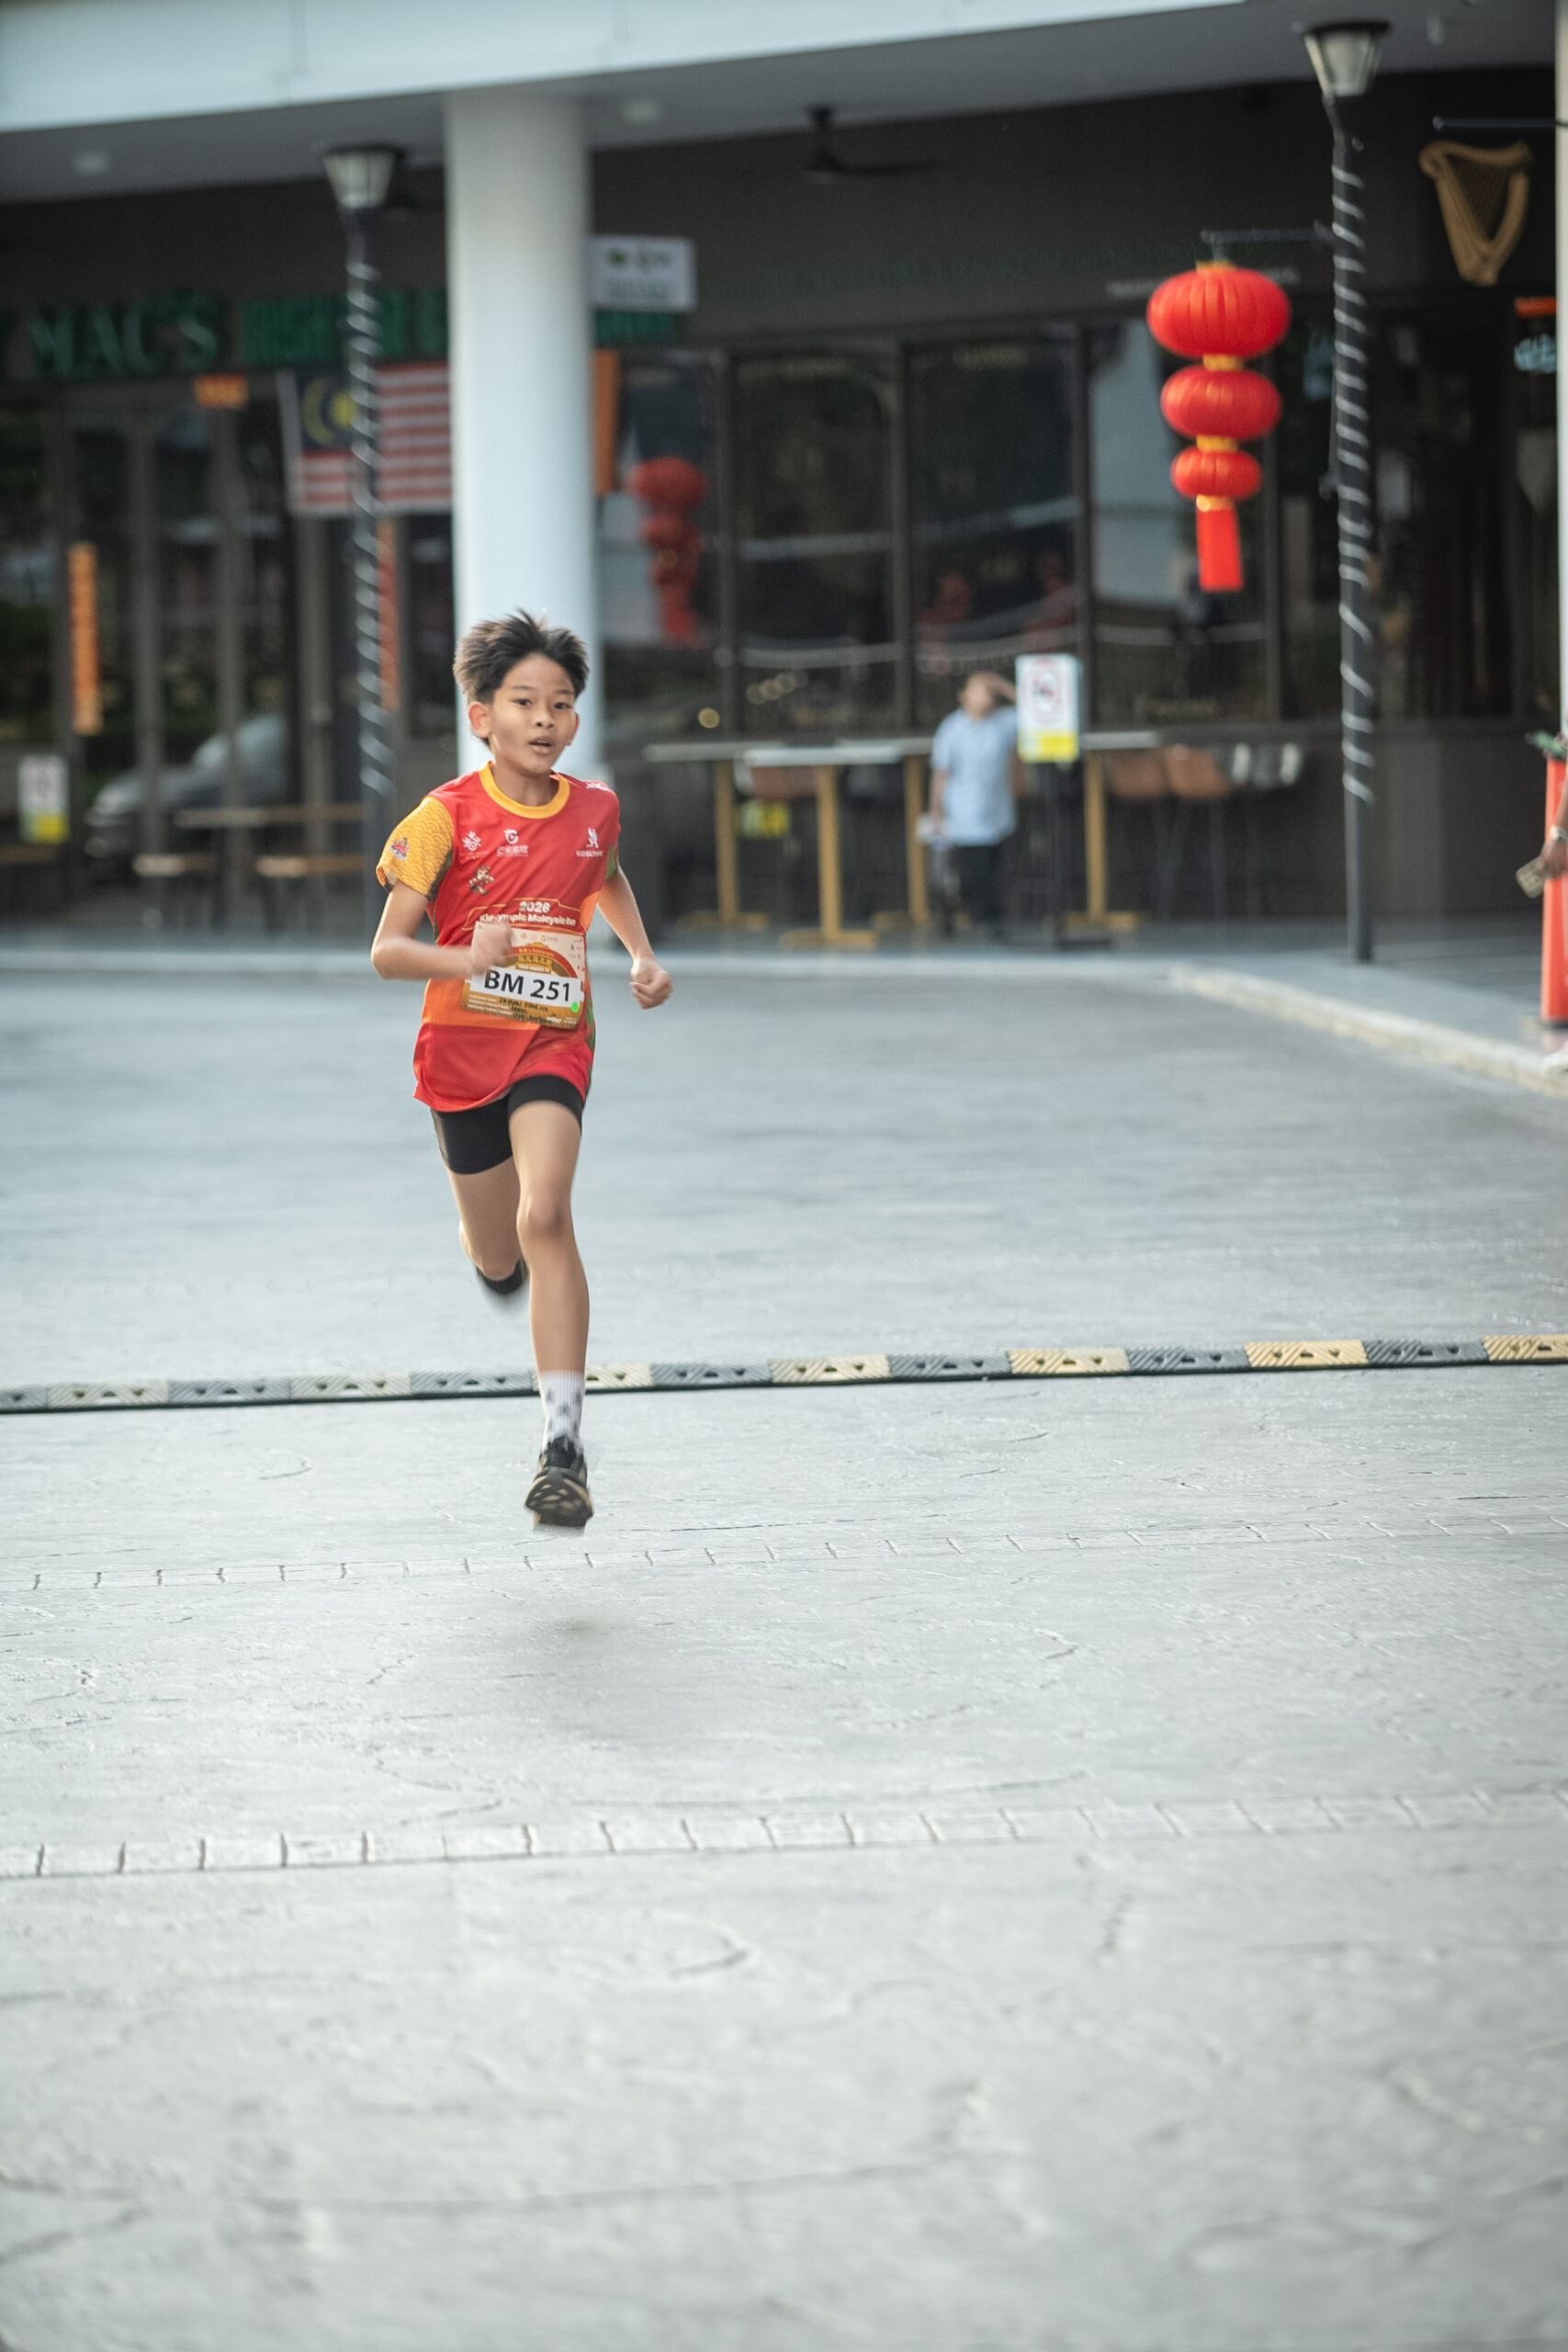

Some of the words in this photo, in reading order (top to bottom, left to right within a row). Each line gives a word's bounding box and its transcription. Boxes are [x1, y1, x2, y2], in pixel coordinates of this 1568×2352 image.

[519, 901, 551, 913] 2026
[484, 969, 525, 995] BM
[530, 978, 570, 1001] 251
